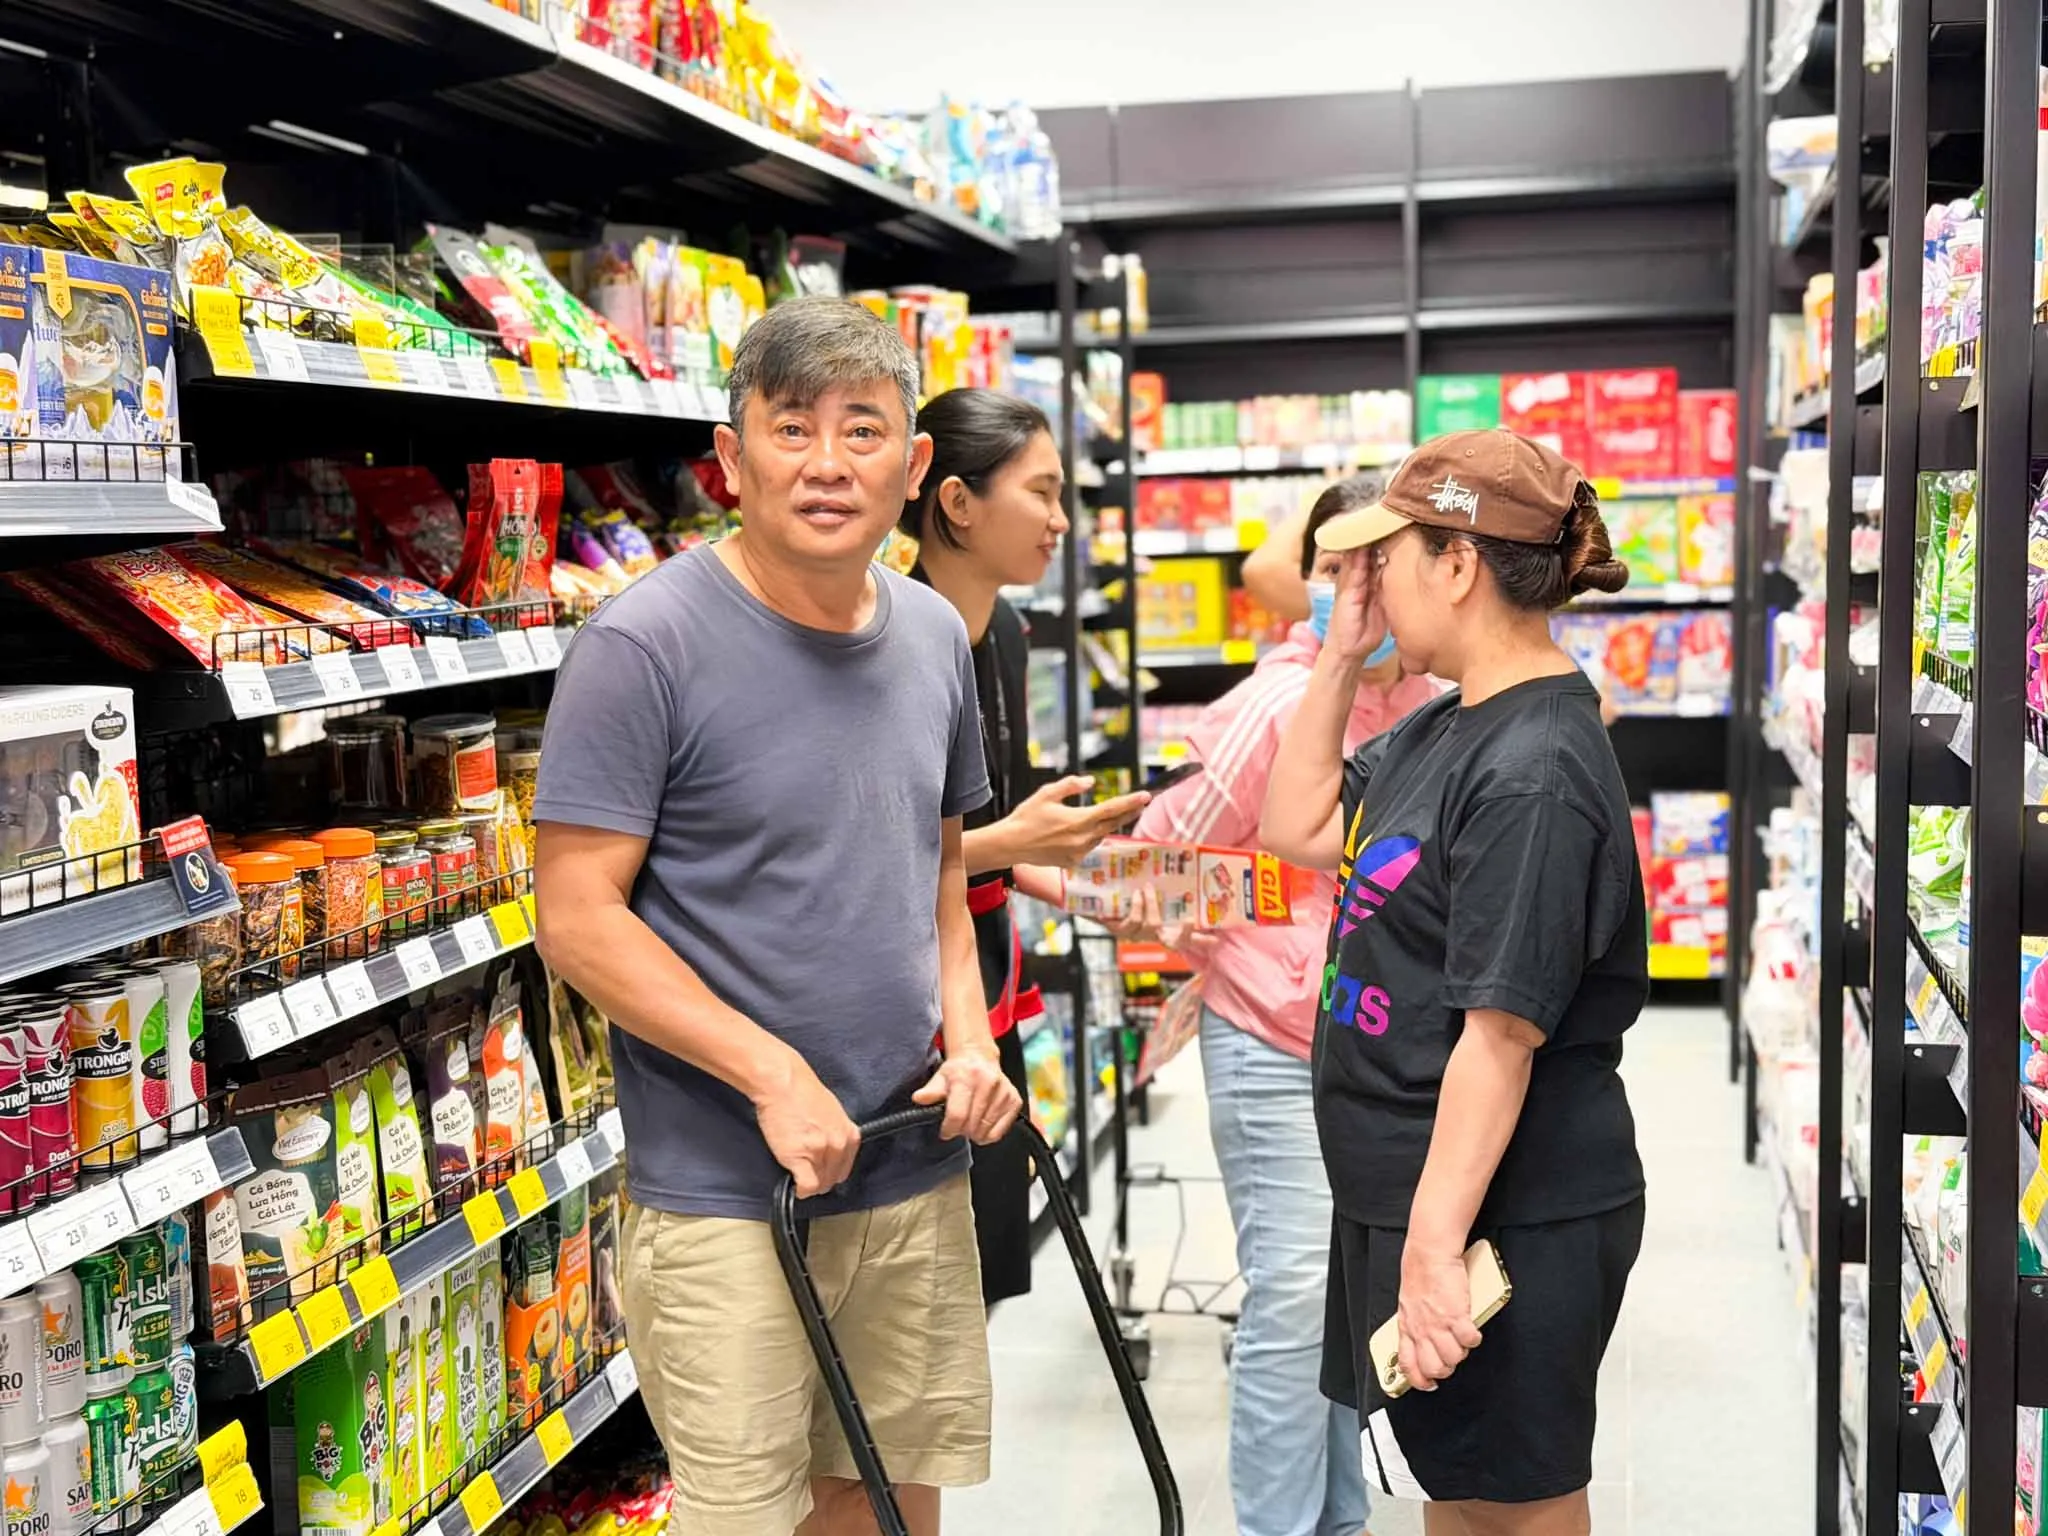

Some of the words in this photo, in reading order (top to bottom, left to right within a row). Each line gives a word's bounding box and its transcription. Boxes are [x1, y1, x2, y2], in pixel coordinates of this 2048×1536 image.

[192, 1169, 204, 1184] 23
[158, 1186, 170, 1202] 23
[249, 1184, 264, 1196] Cá
[105, 1211, 118, 1228] 23
[66, 1230, 80, 1246] 23
[8, 1257, 25, 1273] 25
[313, 1447, 339, 1461] BIG
[235, 1489, 247, 1505] 18
